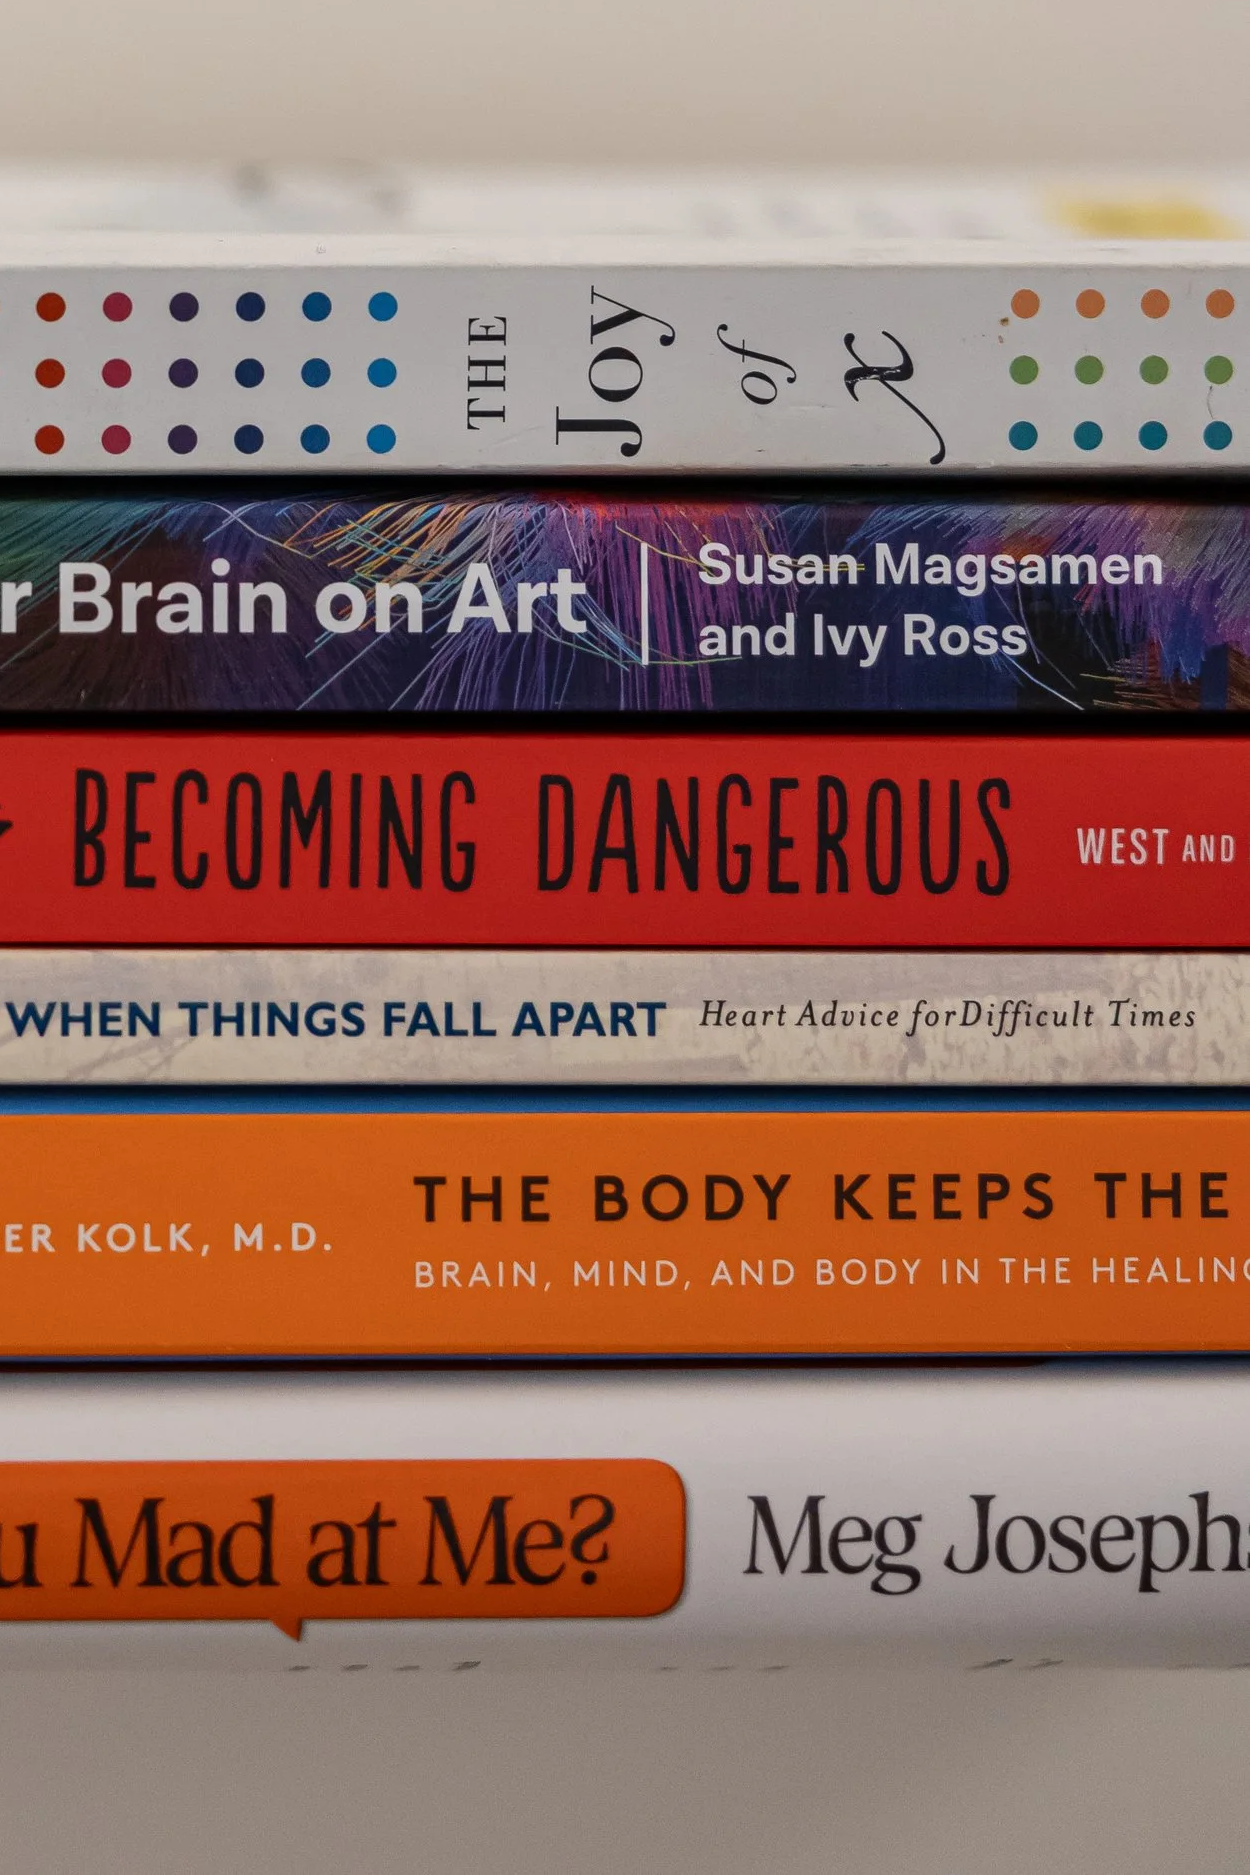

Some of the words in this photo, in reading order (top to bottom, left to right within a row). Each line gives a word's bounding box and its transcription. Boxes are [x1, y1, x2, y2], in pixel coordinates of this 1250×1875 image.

[466, 316, 507, 431] THE
[555, 285, 676, 458] Joy
[716, 323, 797, 406] of
[843, 330, 946, 467] x
[58, 557, 287, 634] Brain
[315, 576, 426, 635] on
[447, 562, 588, 635] Art
[698, 542, 858, 586] Susan
[875, 542, 1164, 597] Magsamen
[699, 612, 795, 657] and
[813, 613, 888, 668] Ivy
[903, 613, 1028, 656] Ross
[73, 768, 476, 893] BECOMING
[537, 773, 1011, 897] DANGEROUS
[1076, 827, 1170, 865] WEST
[1181, 834, 1235, 863] AND
[5, 1001, 161, 1038] WHEN
[177, 1001, 366, 1038] THINGS
[383, 1001, 497, 1037] FALL
[511, 1001, 667, 1037] APART
[698, 999, 787, 1027] Heart
[794, 999, 899, 1027] Advice
[1108, 997, 1196, 1028] Times
[413, 1175, 550, 1223] THE
[594, 1174, 791, 1222] BODY
[834, 1172, 1054, 1221] KEEPS
[1093, 1171, 1229, 1219] THE
[77, 1222, 210, 1257] KOLK,
[233, 1222, 332, 1252] M.D.
[415, 1260, 551, 1292] BRAIN,
[573, 1259, 691, 1291] MIND,
[710, 1258, 795, 1286] AND
[815, 1258, 921, 1286] BODY
[941, 1258, 979, 1285] IN
[998, 1257, 1071, 1284] THE
[1092, 1256, 1250, 1284] HEALIN
[70, 1494, 281, 1589] Mad
[306, 1502, 397, 1588] at
[418, 1494, 615, 1587] Me?
[742, 1495, 923, 1596] Meg
[943, 1490, 1250, 1594] Joseph
